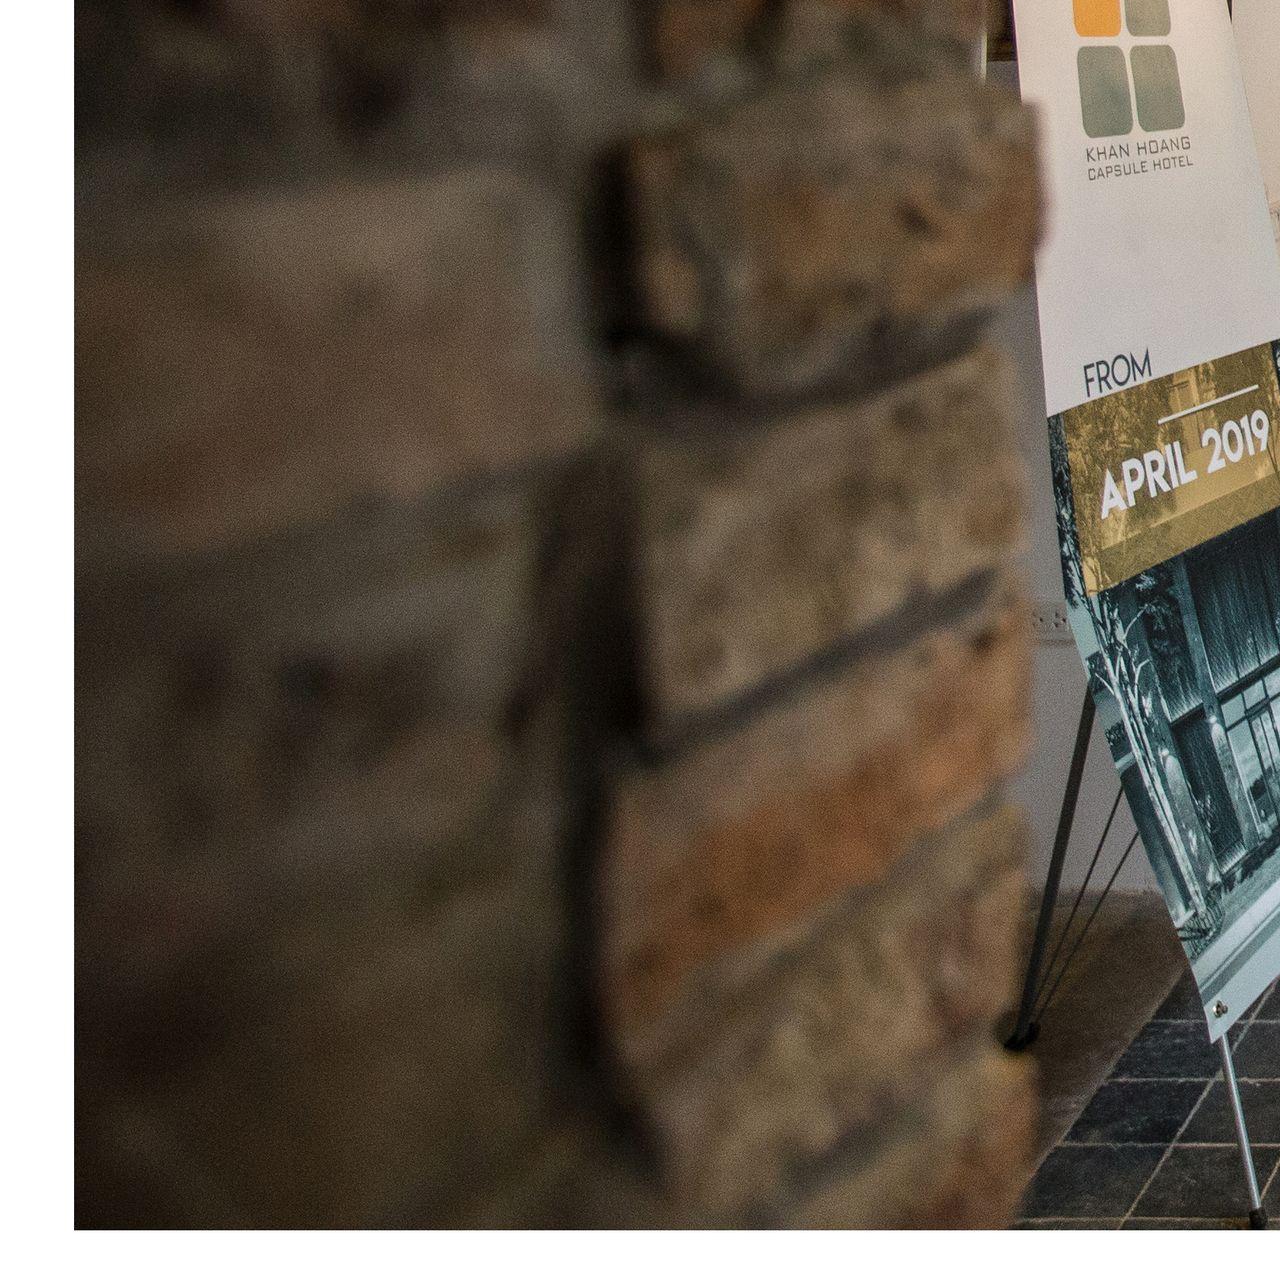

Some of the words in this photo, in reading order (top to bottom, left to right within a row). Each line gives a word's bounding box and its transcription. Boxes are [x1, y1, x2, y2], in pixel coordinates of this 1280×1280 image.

[1086, 144, 1130, 163] KHAN
[1137, 136, 1191, 156] HOANG
[1088, 161, 1149, 181] CAPSULE
[1153, 155, 1194, 172] HOTEL
[1083, 346, 1152, 398] FROM
[1101, 440, 1198, 520] APRIL
[1201, 409, 1270, 474] 2019
